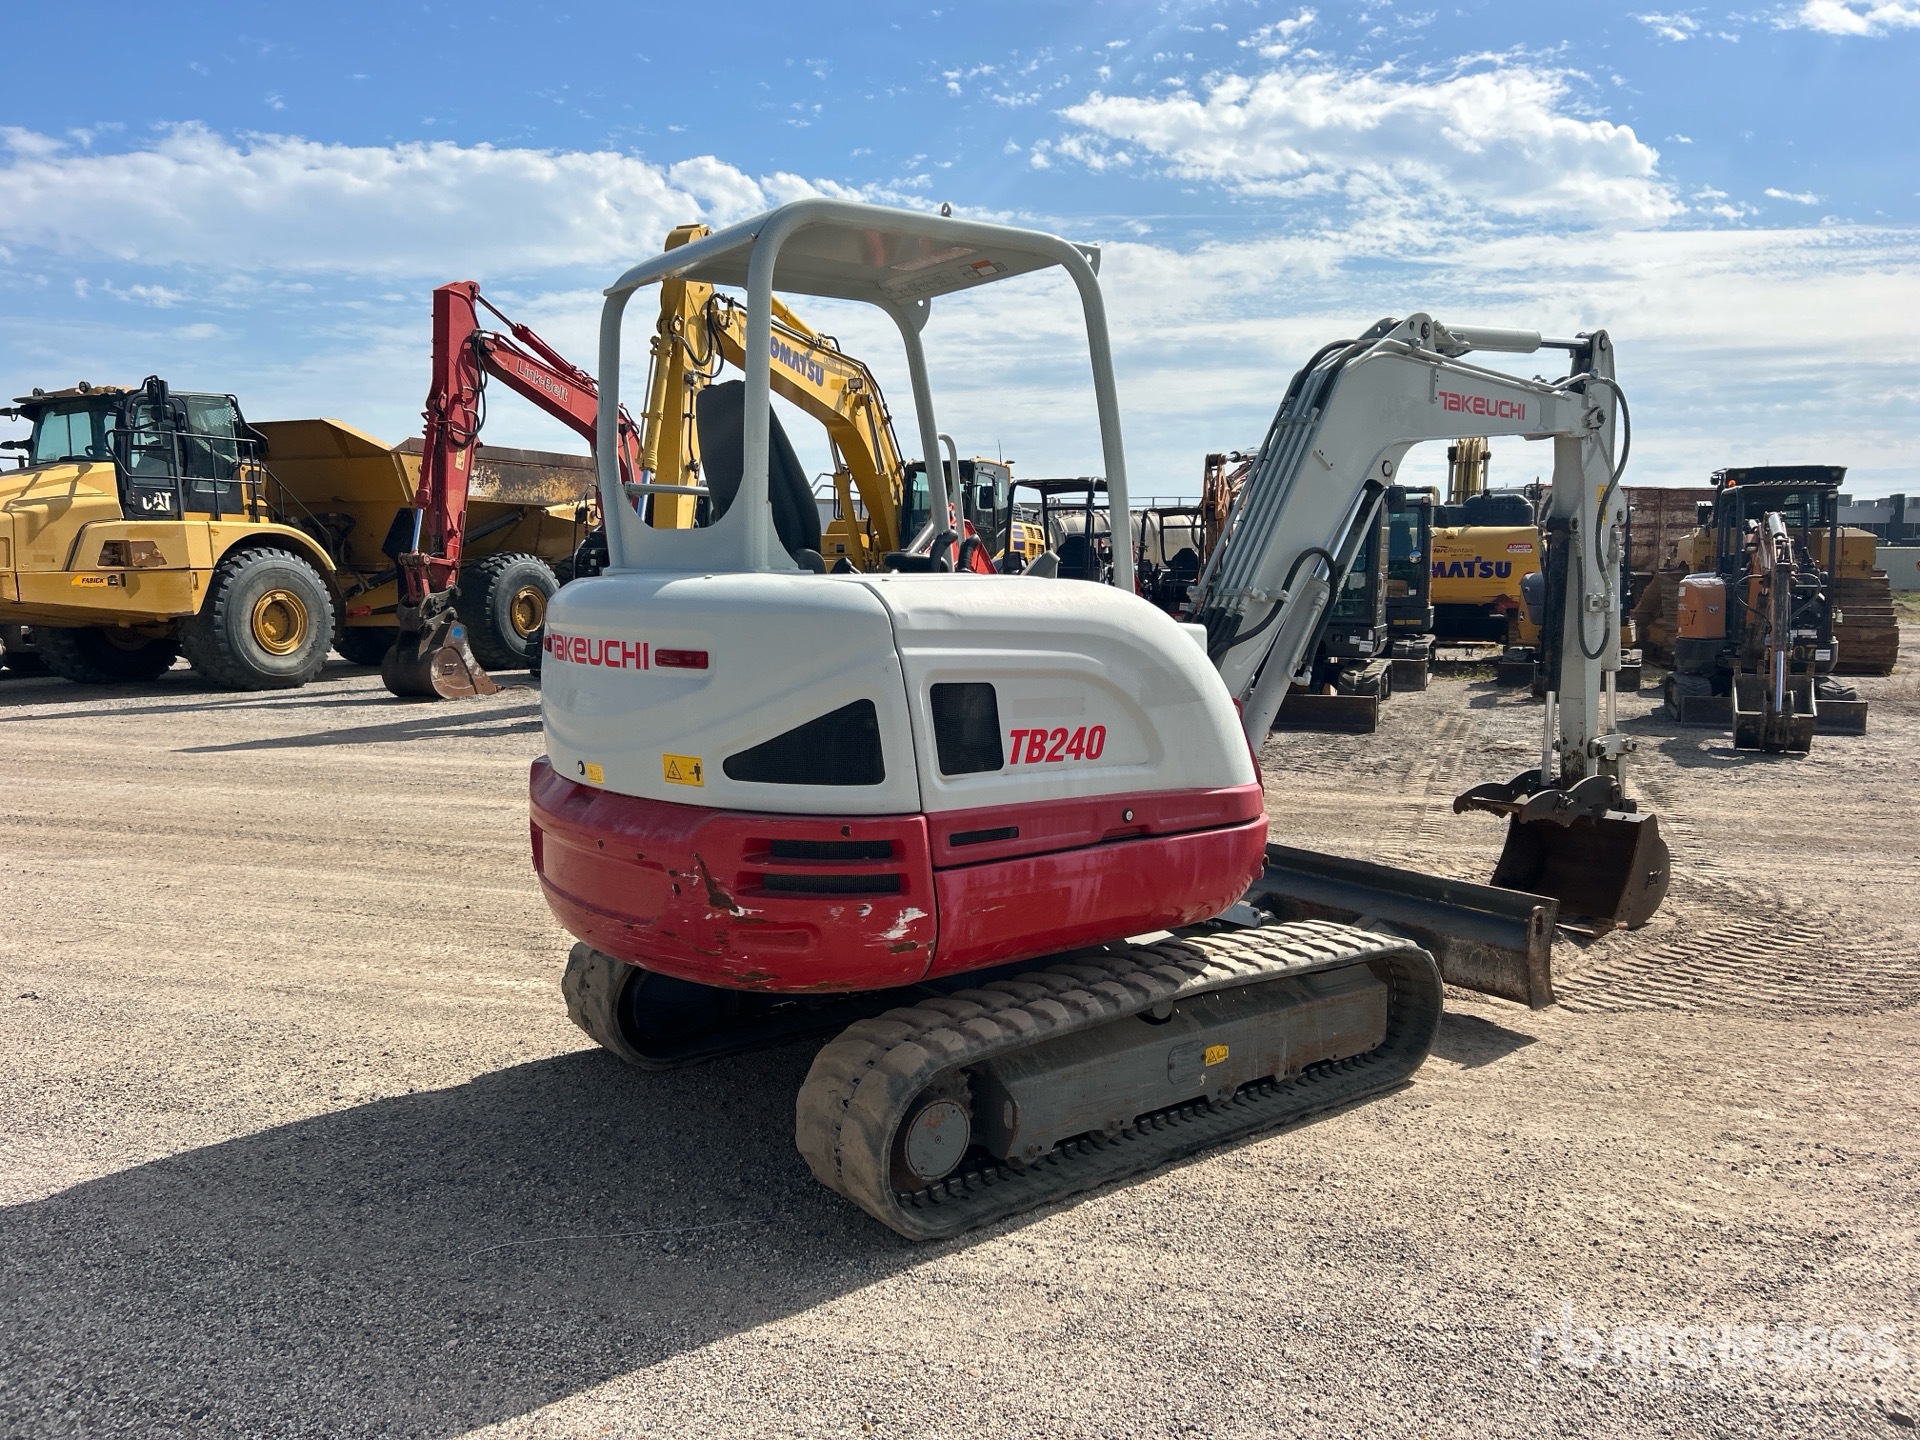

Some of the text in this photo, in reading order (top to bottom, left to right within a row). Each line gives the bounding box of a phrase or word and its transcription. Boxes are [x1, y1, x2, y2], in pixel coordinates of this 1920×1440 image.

[517, 359, 568, 402] Link-Belt
[770, 336, 824, 387] OMATSU
[142, 491, 172, 511] CAT
[1432, 556, 1512, 578] MATSU
[1009, 725, 1107, 765] TB240
